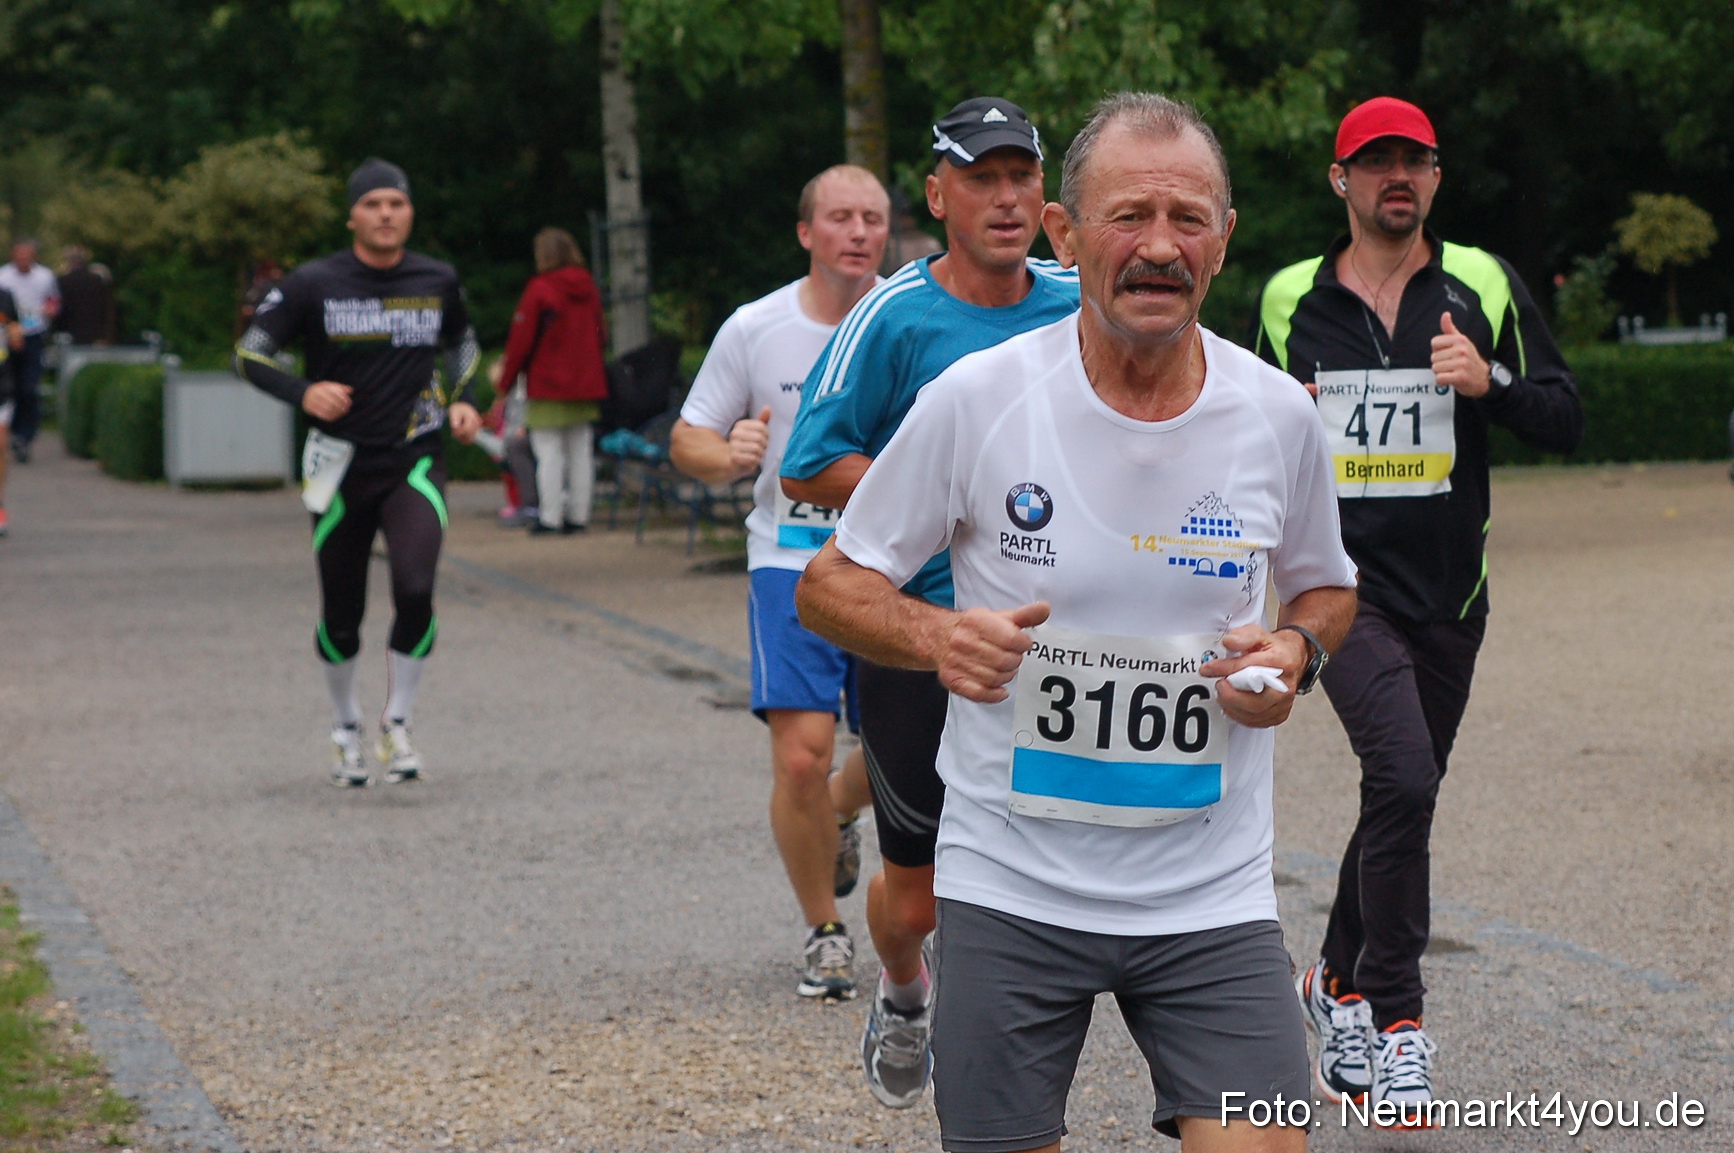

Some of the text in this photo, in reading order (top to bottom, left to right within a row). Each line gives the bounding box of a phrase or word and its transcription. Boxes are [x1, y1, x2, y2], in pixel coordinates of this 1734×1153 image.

[1320, 383, 1429, 396] PARTL Neumarkt
[1345, 402, 1421, 446] 471
[1346, 460, 1424, 478] Bernhard
[1010, 483, 1050, 502] BMW
[1000, 531, 1057, 555] PARTL
[1130, 534, 1164, 552] 14.
[1001, 547, 1056, 568] Neumarkt
[1027, 641, 1197, 674] PARTL Neumarkt
[1036, 674, 1211, 754] 3166
